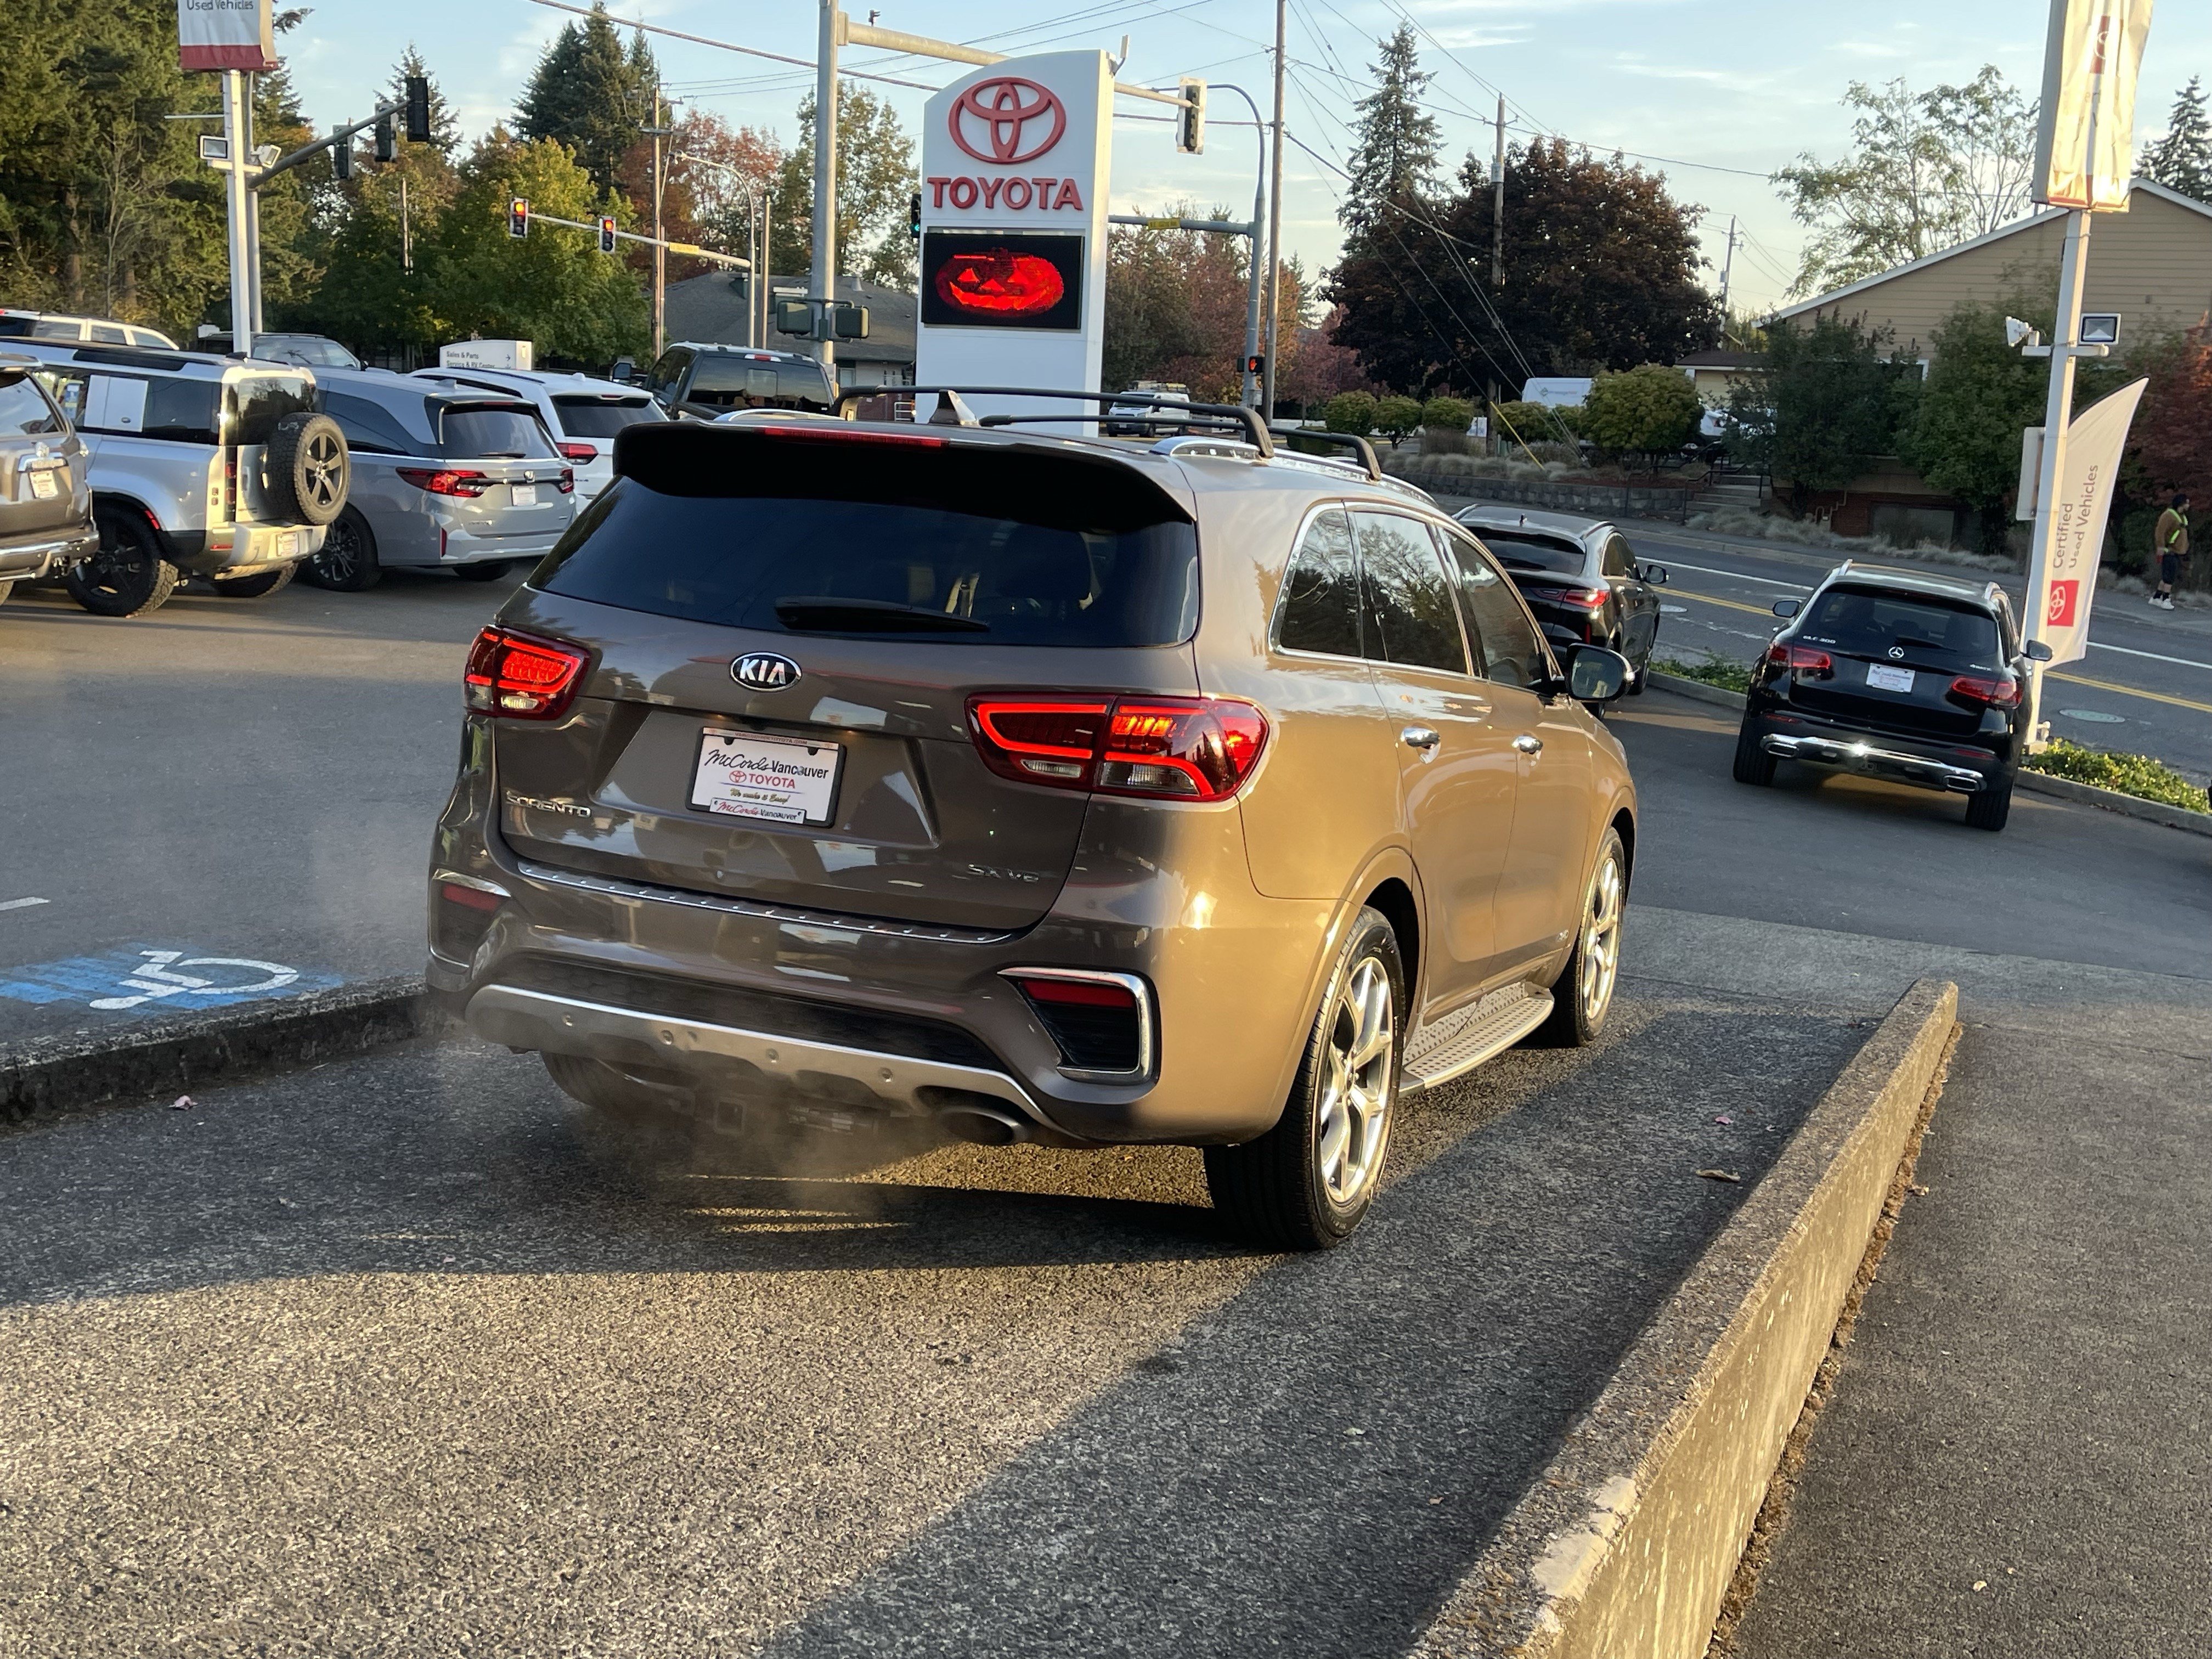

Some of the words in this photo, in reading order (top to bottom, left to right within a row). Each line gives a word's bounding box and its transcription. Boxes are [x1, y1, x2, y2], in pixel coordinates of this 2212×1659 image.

[187, 0, 213, 10] Used
[927, 176, 1084, 211] TOYOTA
[2076, 465, 2098, 527] Vehicles
[2053, 503, 2073, 568] Certified
[2069, 531, 2085, 568] Used
[740, 658, 786, 685] KIA
[704, 749, 772, 771] McCords
[749, 773, 795, 788] TOYOTA
[506, 791, 591, 818] SORENTO
[716, 802, 760, 815] McCords
[760, 809, 797, 820] Vancouver
